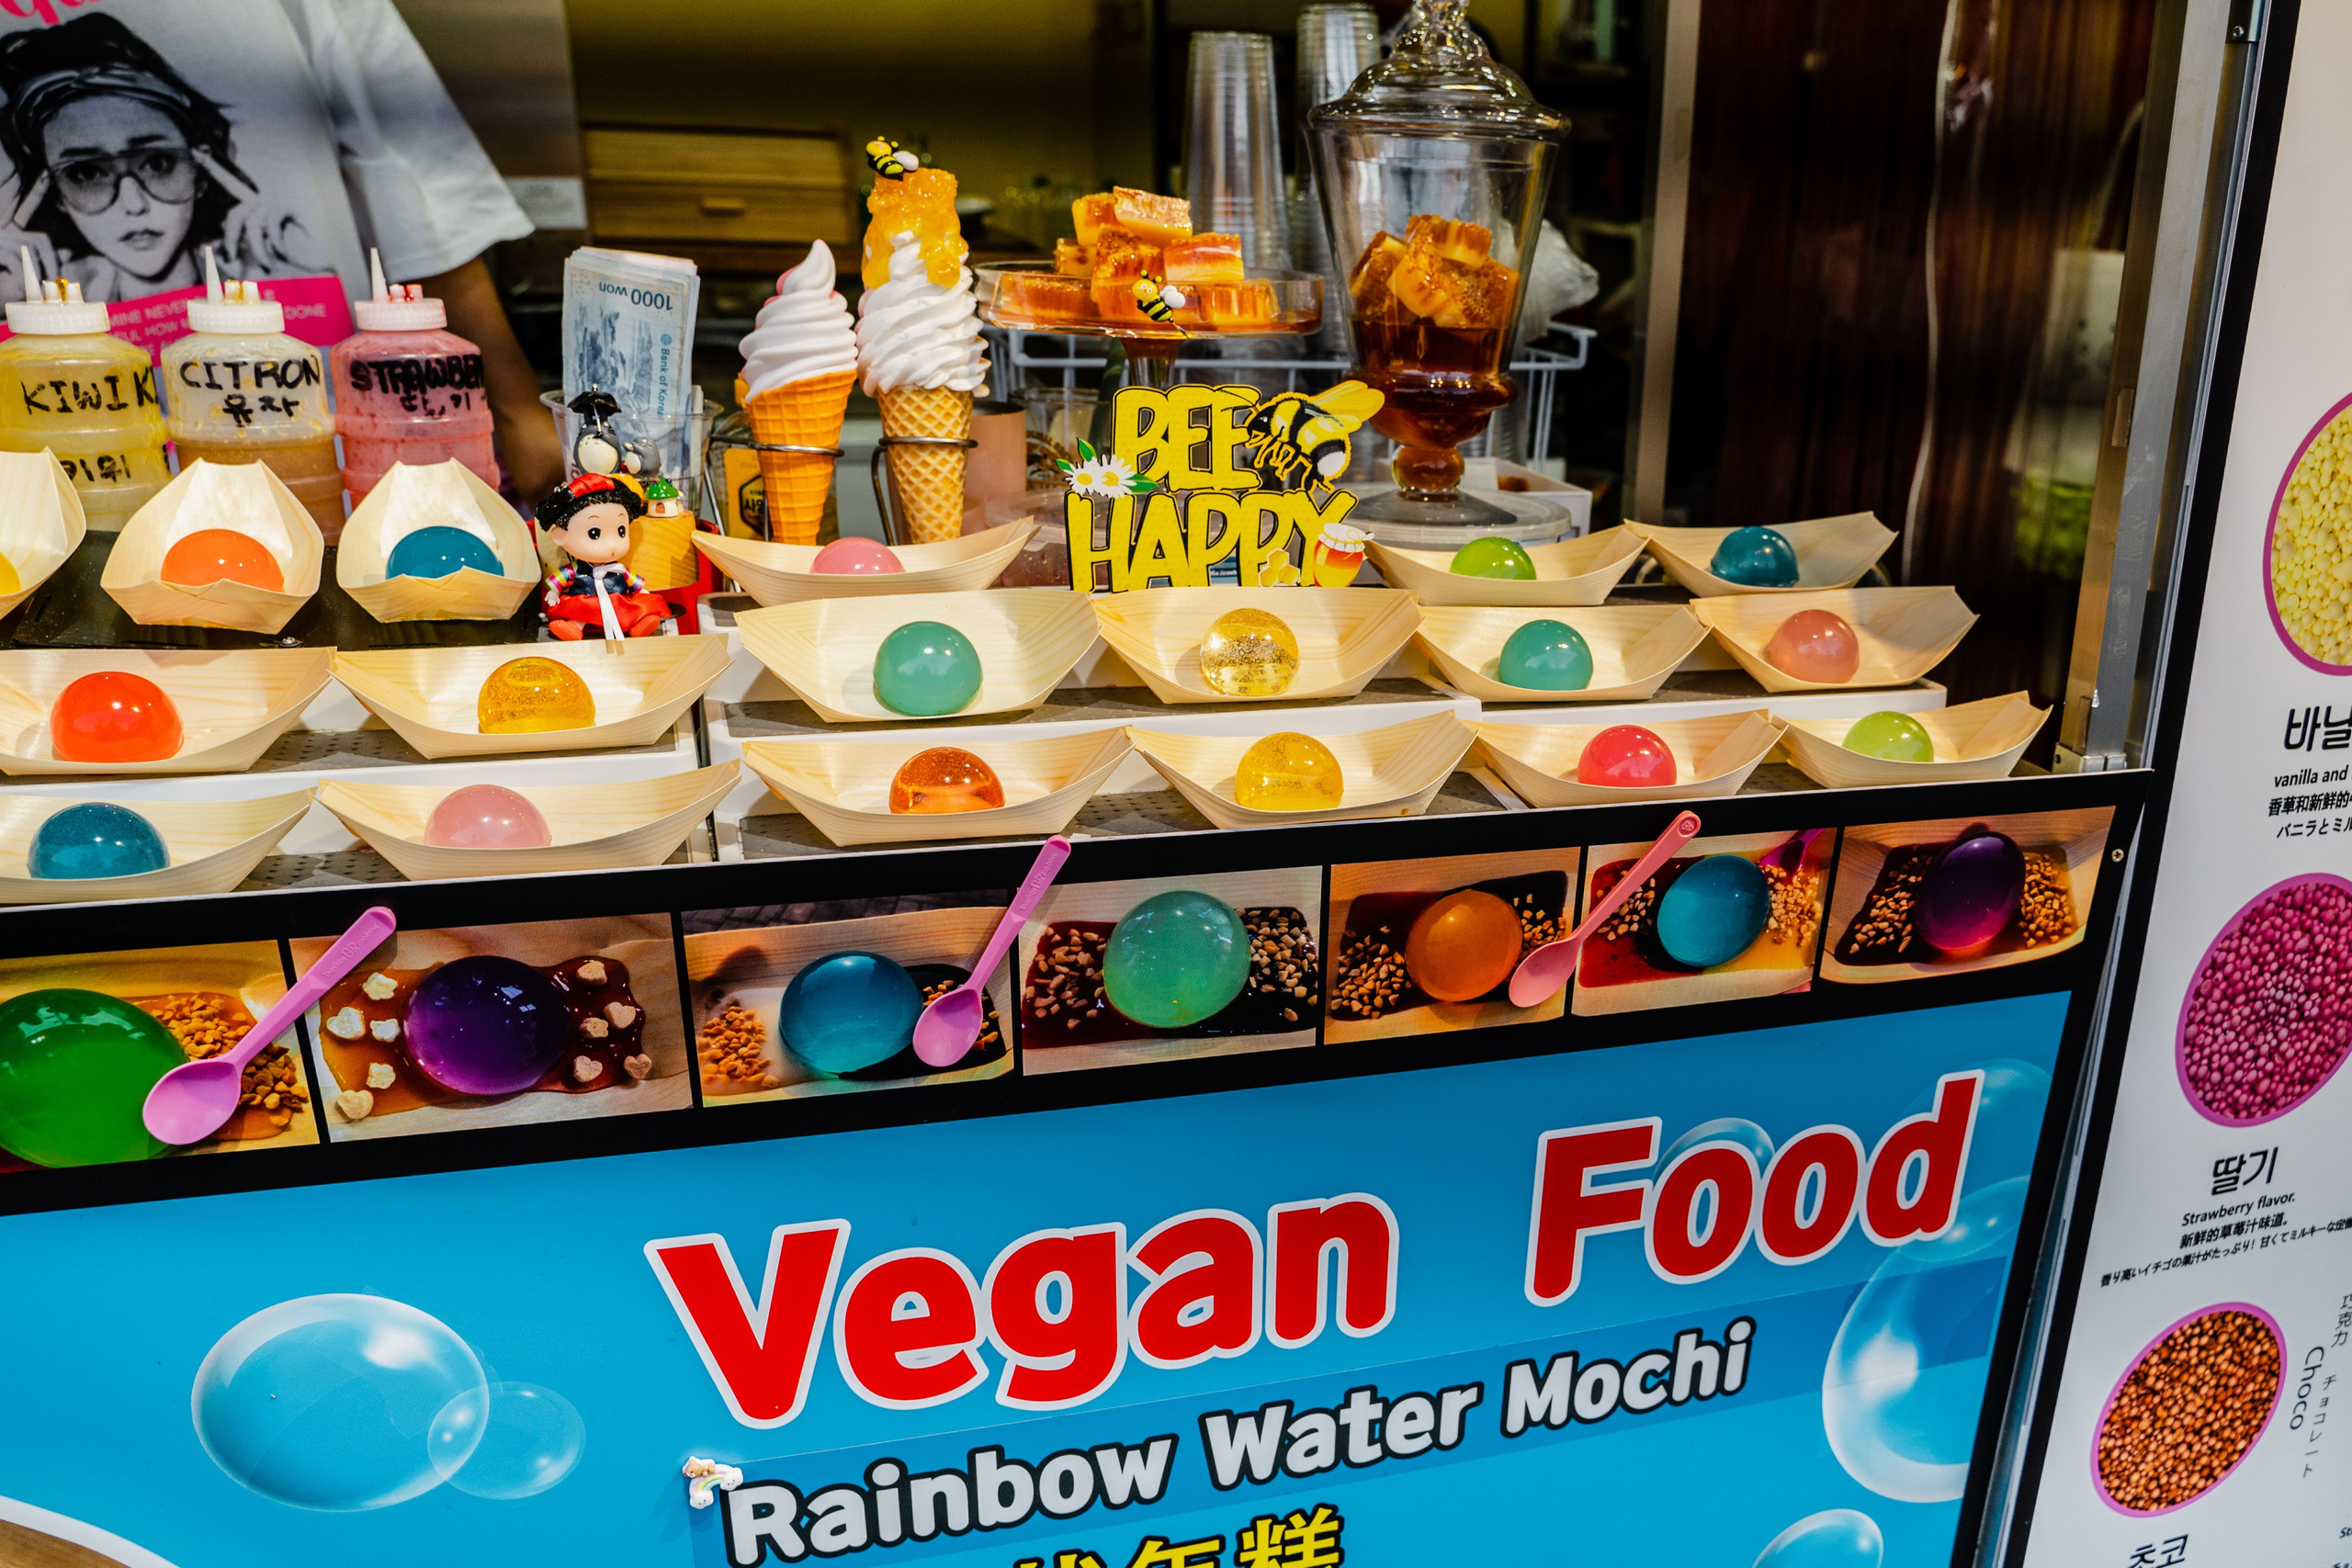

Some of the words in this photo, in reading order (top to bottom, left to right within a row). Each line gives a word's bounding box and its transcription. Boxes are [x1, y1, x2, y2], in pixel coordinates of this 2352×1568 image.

[599, 281, 628, 297] won
[631, 289, 673, 311] 1000
[180, 355, 321, 389] CITRON
[660, 348, 671, 373] Bank
[1112, 384, 1262, 493] BEE
[1064, 488, 1359, 593] HAPPY
[2275, 768, 2318, 787] vanilla
[2322, 764, 2349, 783] and
[2211, 1146, 2278, 1195] 딸기
[2181, 1201, 2255, 1226] Strawberry
[2256, 1192, 2295, 1210] flavor.
[650, 1196, 1395, 1426] Vegan
[1529, 1075, 1981, 1304] Food
[2290, 1347, 2324, 1430] Choco
[725, 1436, 1175, 1567] Rainbow
[1203, 1384, 1480, 1488] Water
[1504, 1320, 1753, 1436] Mochi
